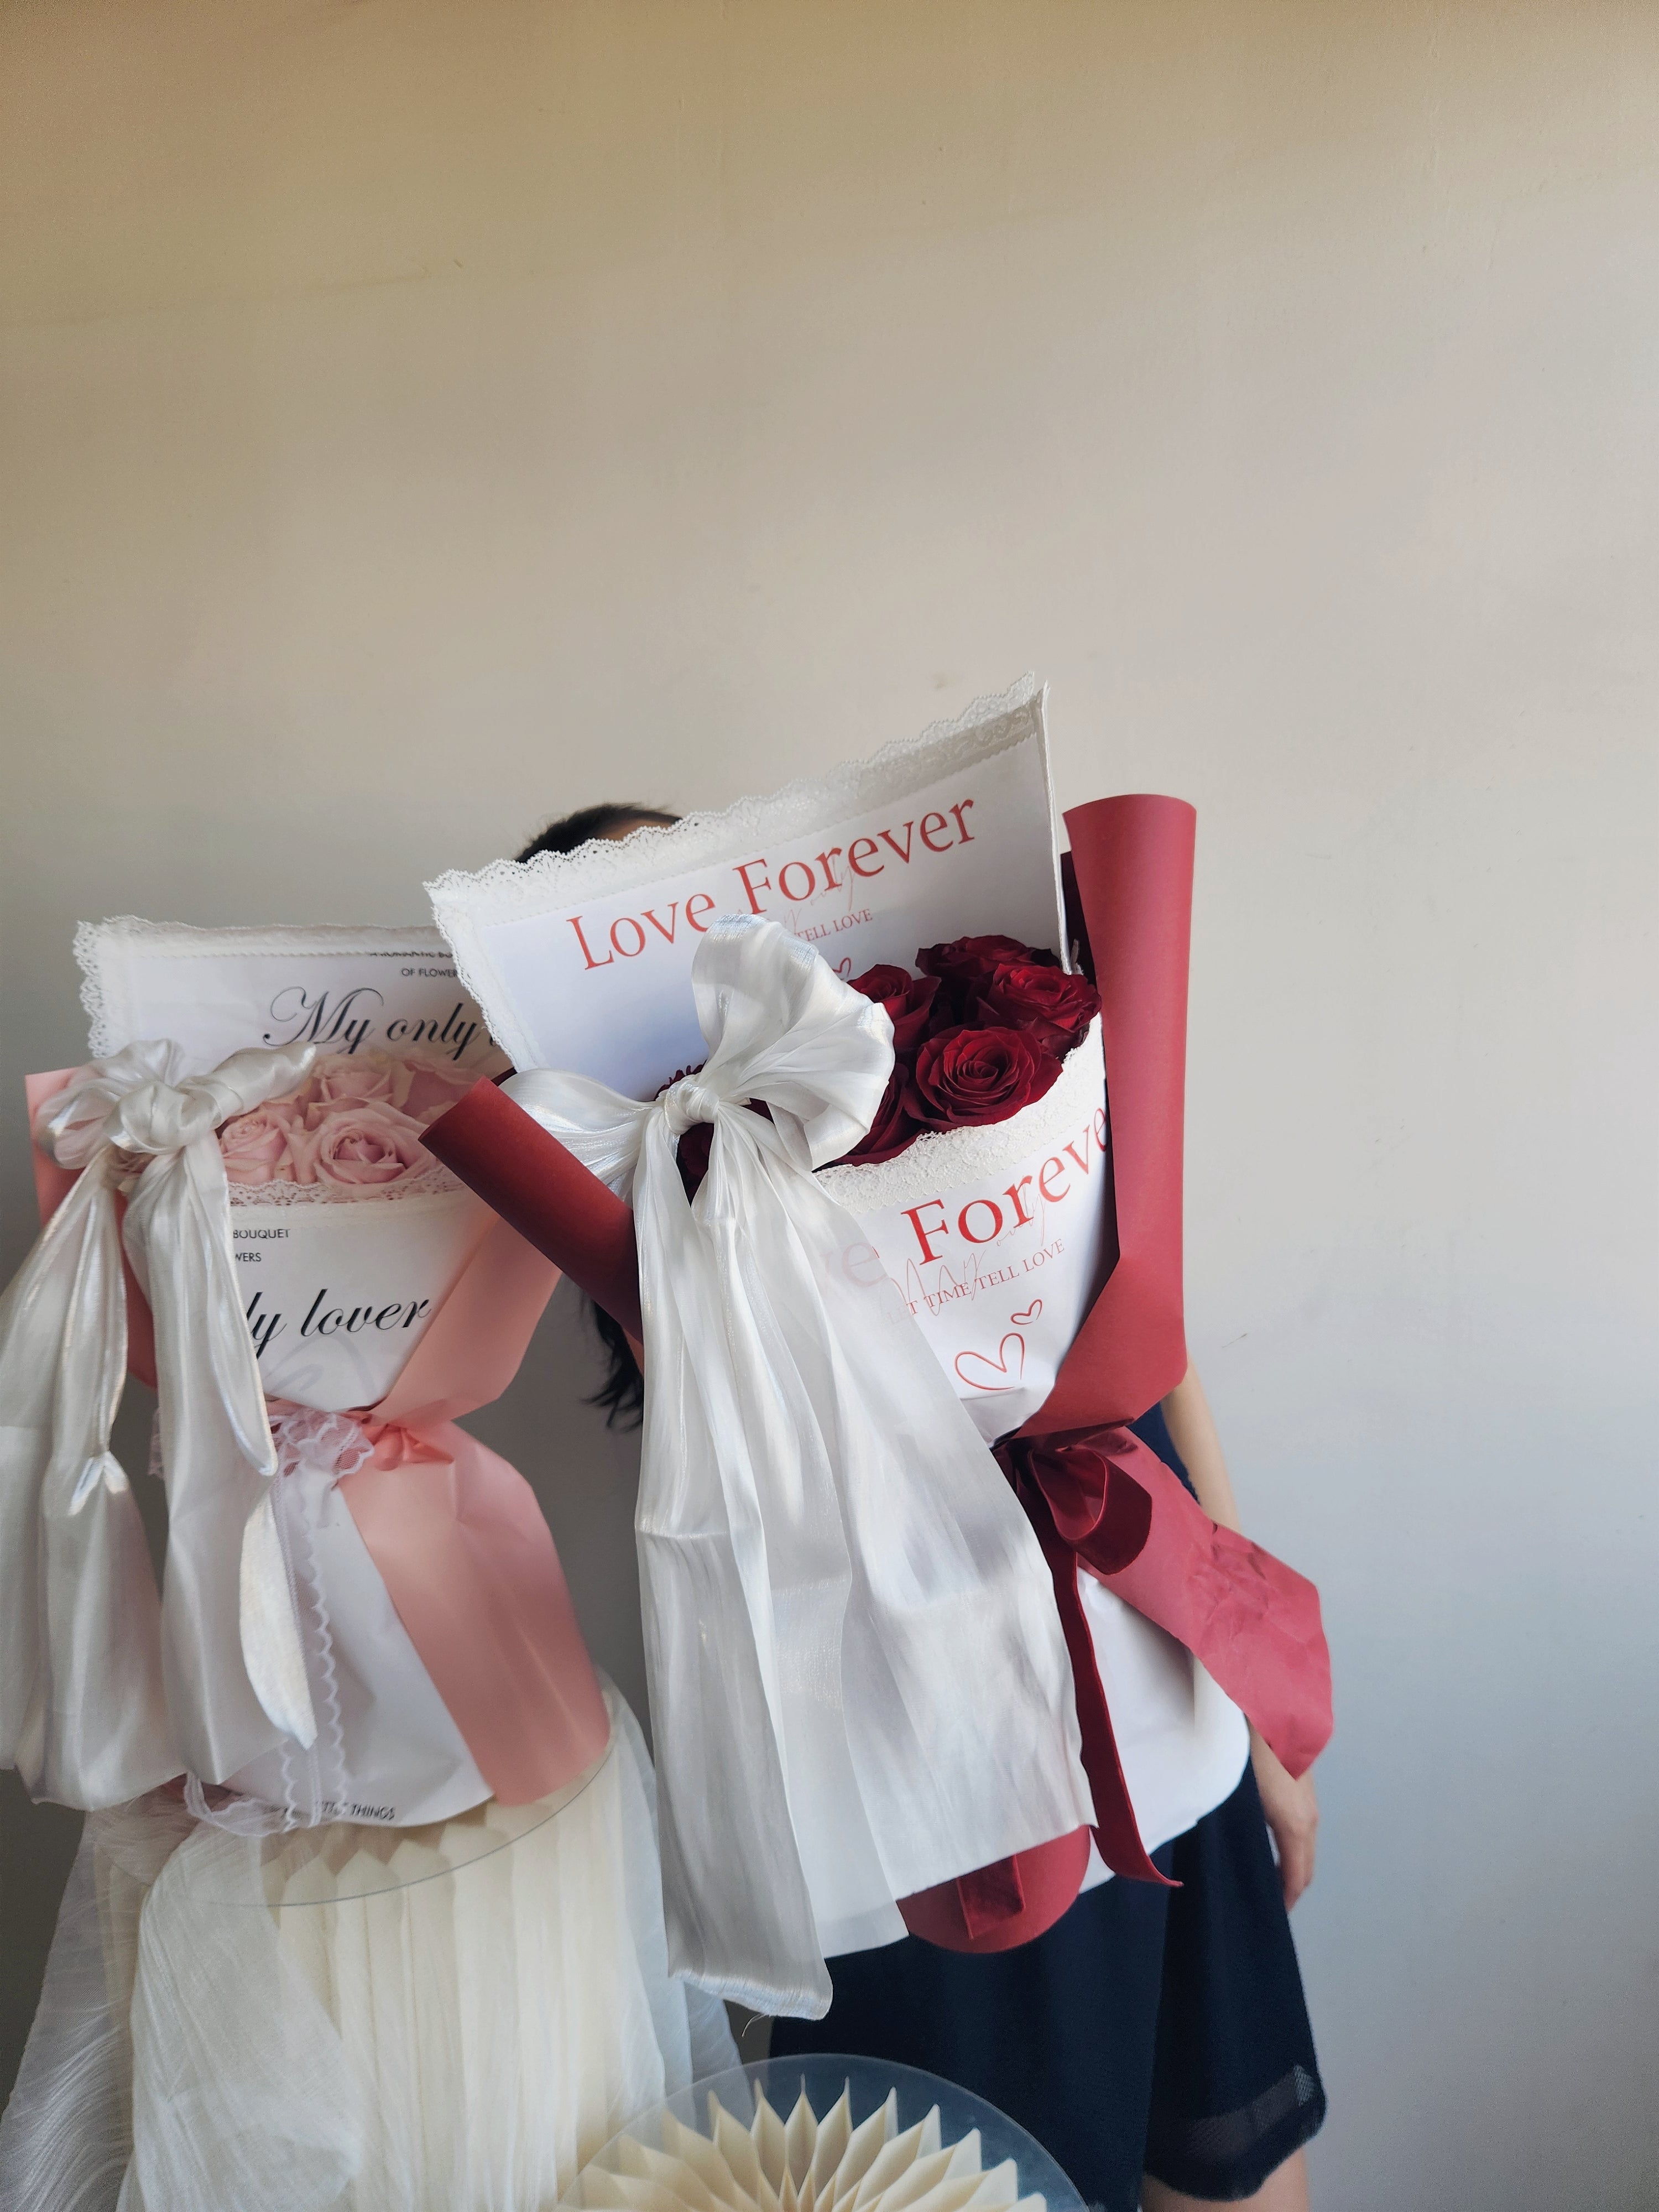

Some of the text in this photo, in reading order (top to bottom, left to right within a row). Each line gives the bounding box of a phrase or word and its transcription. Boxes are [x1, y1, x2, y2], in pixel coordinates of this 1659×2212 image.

[566, 799, 975, 970] Love Forever
[833, 909, 873, 931] LOVE
[401, 968, 458, 978] OF FLOWER
[263, 986, 480, 1061] My only
[900, 1108, 1107, 1265] Foreve
[233, 1228, 291, 1239] BOUQUET
[235, 1252, 262, 1262] WERS
[924, 1282, 972, 1308] TIME
[974, 1265, 1020, 1290] TELL
[1022, 1238, 1065, 1272] LOVE
[300, 1288, 432, 1337] lover
